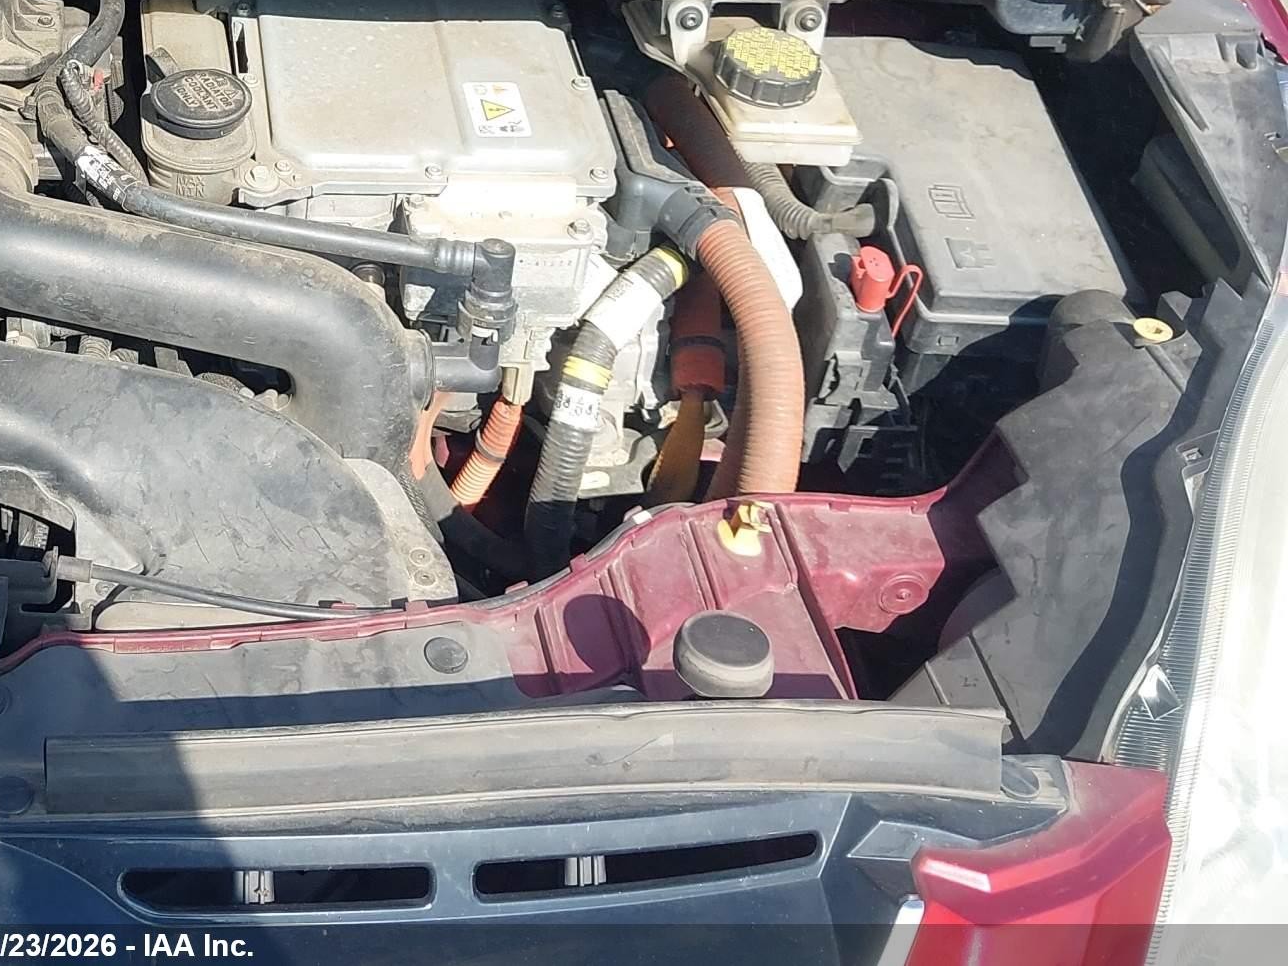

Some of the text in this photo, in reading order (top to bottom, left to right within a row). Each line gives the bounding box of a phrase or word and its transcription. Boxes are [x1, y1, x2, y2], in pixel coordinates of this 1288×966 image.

[176, 87, 200, 107] ONLY
[184, 77, 219, 111] COOLANT
[197, 72, 233, 109] RADIATOR
[176, 174, 206, 187] MAX
